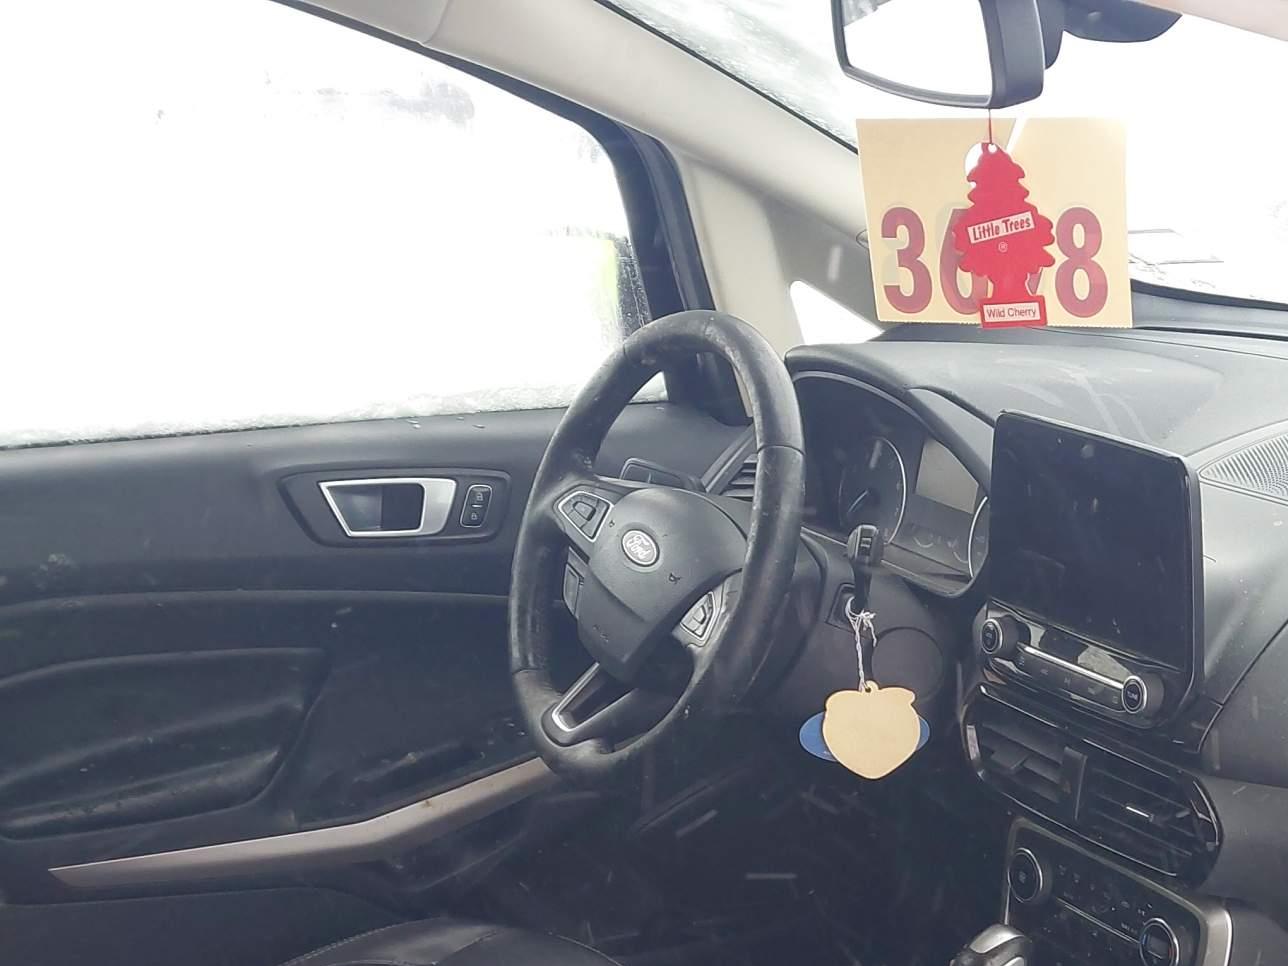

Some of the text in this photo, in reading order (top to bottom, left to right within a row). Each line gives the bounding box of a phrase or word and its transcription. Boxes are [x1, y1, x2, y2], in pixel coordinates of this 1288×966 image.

[972, 216, 1031, 241] Little Trees
[881, 206, 1109, 318] 368
[986, 306, 1037, 318] Wild Cherry
